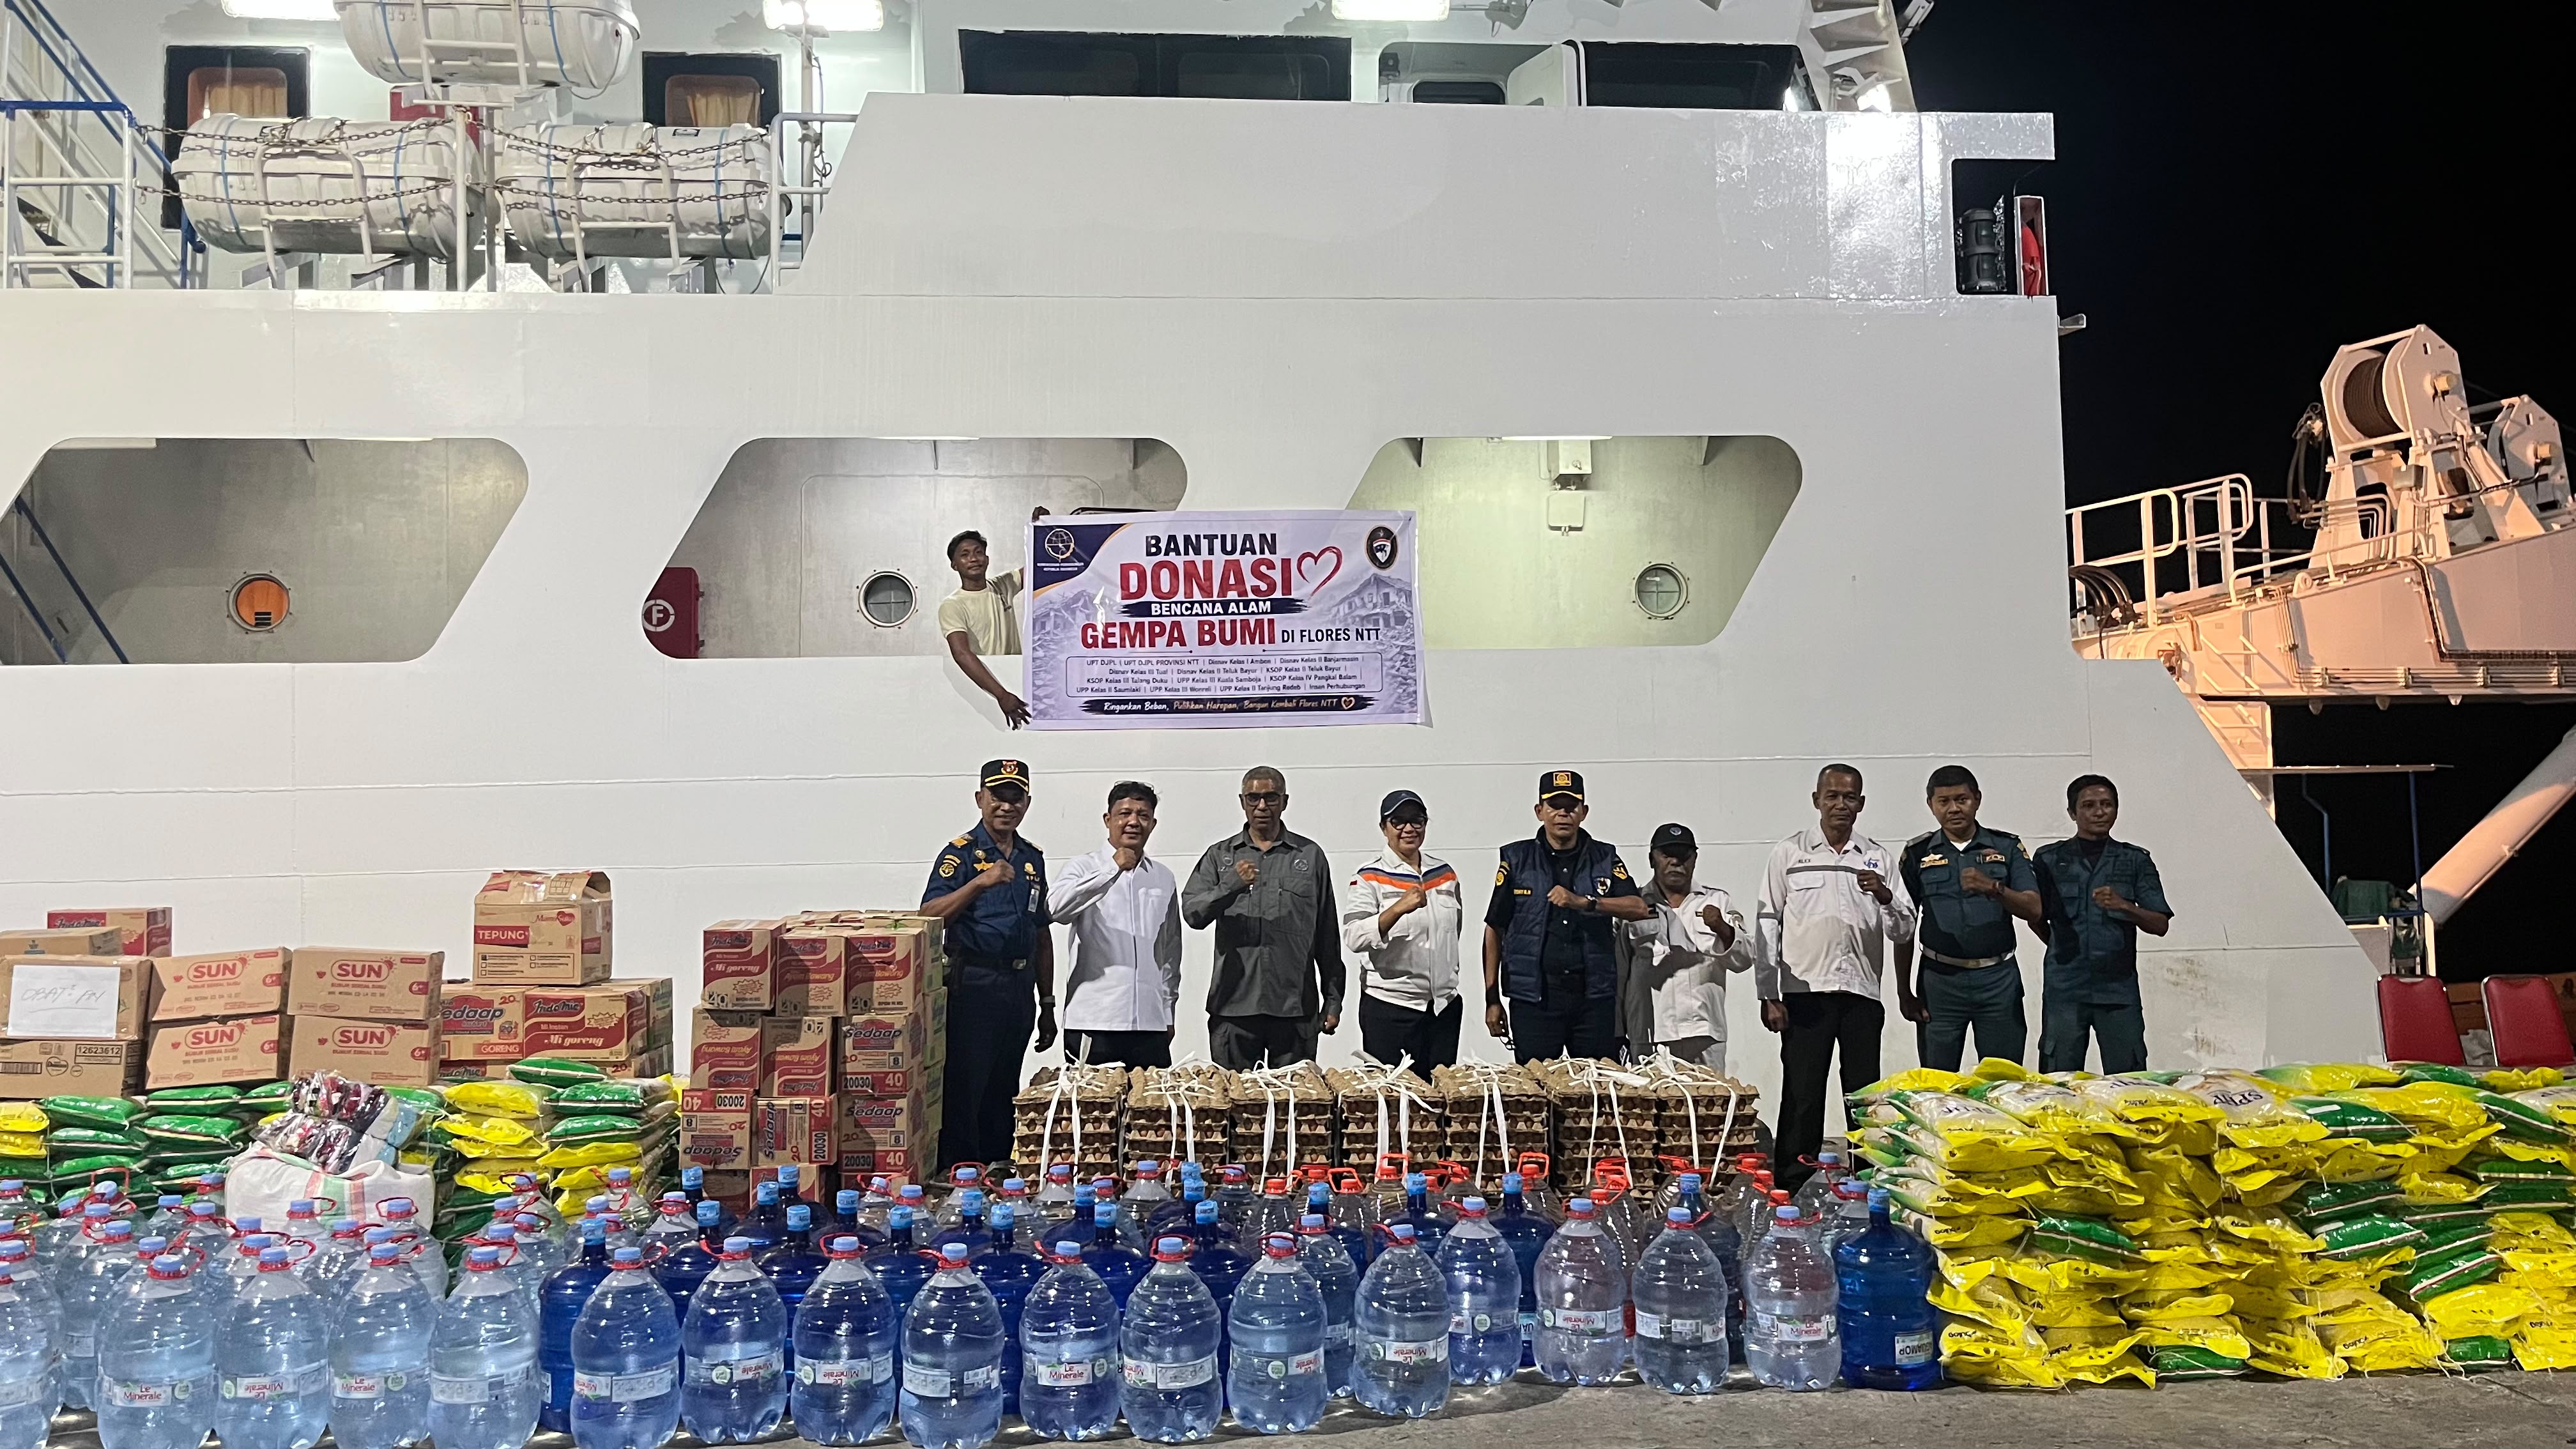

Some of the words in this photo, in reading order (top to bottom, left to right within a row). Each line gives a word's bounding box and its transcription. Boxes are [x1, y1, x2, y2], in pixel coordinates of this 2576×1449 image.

[1145, 533, 1277, 557] BANTUAN
[1119, 558, 1292, 601] DONASI
[652, 605, 664, 625] F
[1151, 602, 1225, 617] BENCANA
[1229, 601, 1271, 614] ALAM
[1080, 619, 1187, 649] GEMPA
[1197, 617, 1276, 647] BUMI
[1282, 629, 1294, 643] DI
[1297, 627, 1351, 642] FLORES
[1354, 627, 1381, 641] NTT
[1236, 676, 1261, 684] Samboja
[1103, 702, 1142, 713] Ringankan
[1144, 701, 1169, 711] Beban,
[1298, 698, 1319, 707] Flores
[1321, 698, 1338, 707] NTT
[477, 930, 525, 940] TEPUNG
[193, 962, 237, 979] SUN
[337, 963, 383, 978] SUN
[726, 963, 760, 974] goreng
[875, 969, 904, 978] Bawang
[498, 995, 516, 1006] 20
[440, 1006, 505, 1020] edaap
[191, 1028, 235, 1046] SUN
[339, 1029, 385, 1045] SUN
[845, 1027, 902, 1039] Sedaap
[564, 1035, 604, 1046] goreng
[77, 1046, 121, 1055] 12623612
[481, 1045, 519, 1054] GORENG
[843, 1076, 871, 1089] 20030
[885, 1073, 903, 1086] 40
[683, 1096, 702, 1111] 40
[717, 1094, 745, 1108] 20030
[2214, 1091, 2264, 1107] SPHP
[811, 1099, 825, 1117] 40
[845, 1105, 903, 1118] Sedaap
[764, 1101, 778, 1160] Sedaap
[683, 1144, 744, 1157] Sedaap
[813, 1132, 827, 1160] 20030
[844, 1156, 872, 1167] 20030
[886, 1152, 904, 1165] 40
[1790, 1326, 1822, 1336] Minerale
[1393, 1347, 1427, 1357] Minerale
[741, 1362, 774, 1375] Minerale
[822, 1369, 859, 1379] Minerale
[1048, 1368, 1085, 1381] Minerale
[1064, 1363, 1075, 1373] Le
[355, 1375, 365, 1384] Le
[140, 1383, 151, 1393] Le
[244, 1381, 284, 1393] Minerale
[341, 1383, 376, 1392] Minerale
[123, 1391, 162, 1400] Minerale
